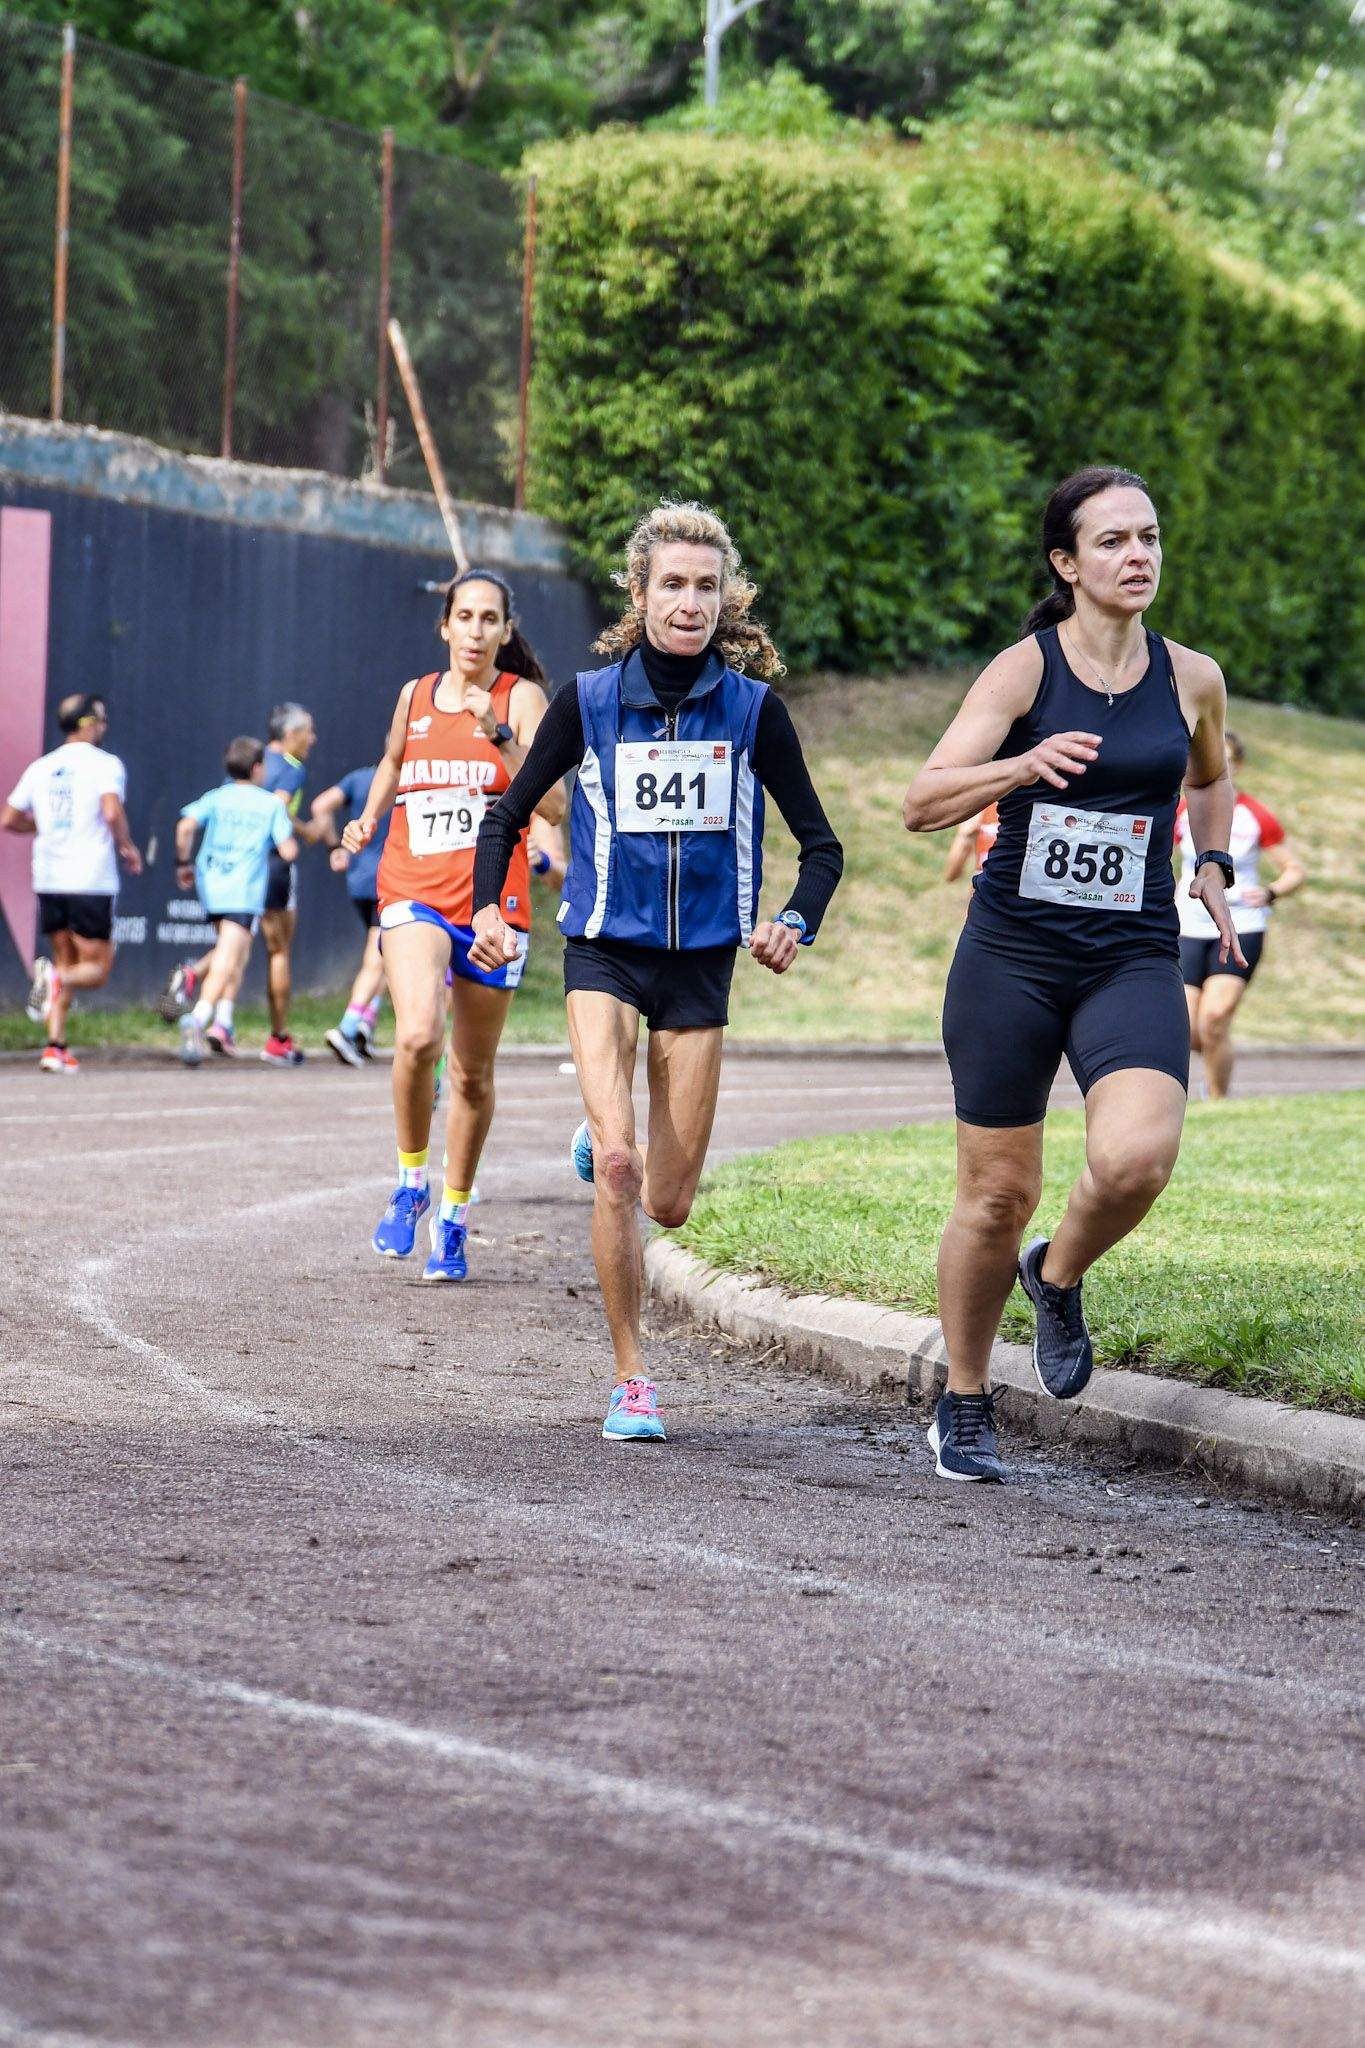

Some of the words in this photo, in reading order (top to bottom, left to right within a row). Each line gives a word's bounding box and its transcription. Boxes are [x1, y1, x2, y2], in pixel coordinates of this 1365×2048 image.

[399, 759, 497, 785] MADRID
[635, 772, 706, 811] 841
[422, 808, 472, 837] 779
[703, 816, 723, 825] 2023
[1044, 838, 1124, 886] 858
[1113, 893, 1136, 903] 2023
